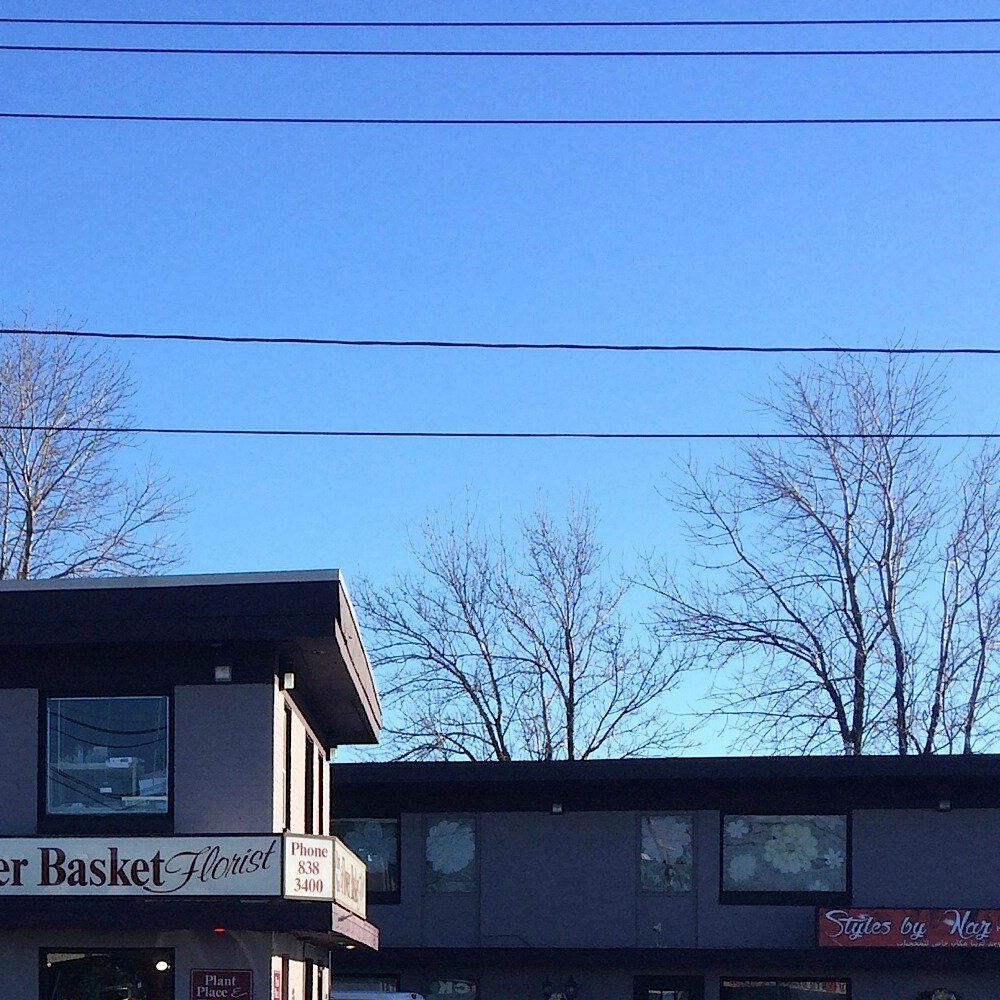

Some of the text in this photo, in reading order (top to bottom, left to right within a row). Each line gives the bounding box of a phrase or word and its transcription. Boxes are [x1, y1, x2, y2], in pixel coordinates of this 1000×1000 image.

[291, 842, 328, 858] Phone
[37, 847, 166, 887] Basket
[142, 839, 277, 893] Florist
[298, 860, 320, 875] 838
[293, 877, 324, 893] 3400
[825, 910, 892, 940] Styles
[900, 917, 927, 940] by
[205, 975, 236, 986] Plant
[197, 986, 228, 997] Place
